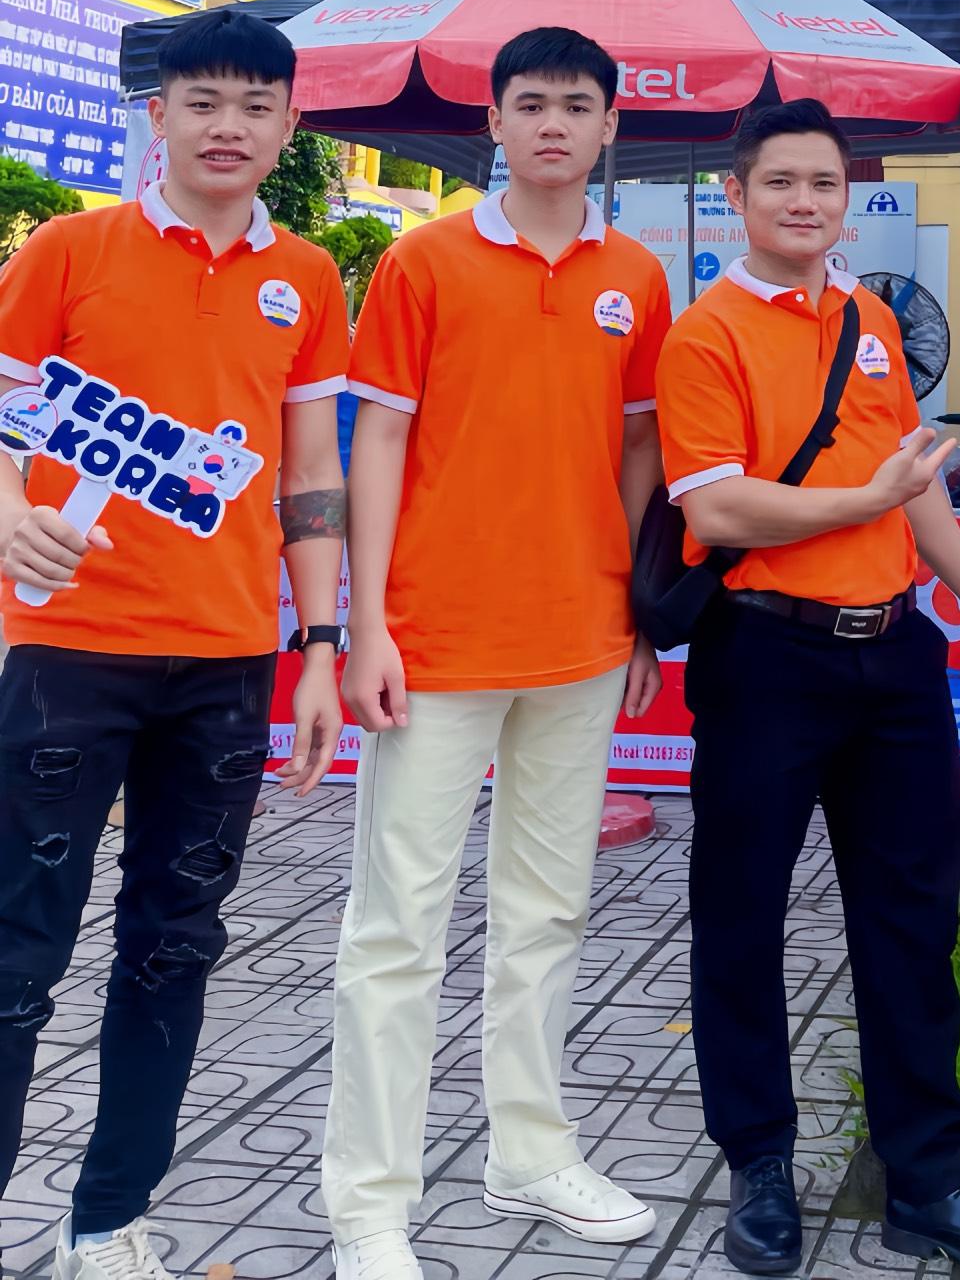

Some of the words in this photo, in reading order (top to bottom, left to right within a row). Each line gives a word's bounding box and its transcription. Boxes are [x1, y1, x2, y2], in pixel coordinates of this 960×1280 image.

[11, 82, 44, 111] BẢN
[46, 89, 75, 118] CỦA
[78, 99, 107, 125] NHÀ
[45, 361, 186, 461] TEAM
[46, 419, 221, 533] KOREA
